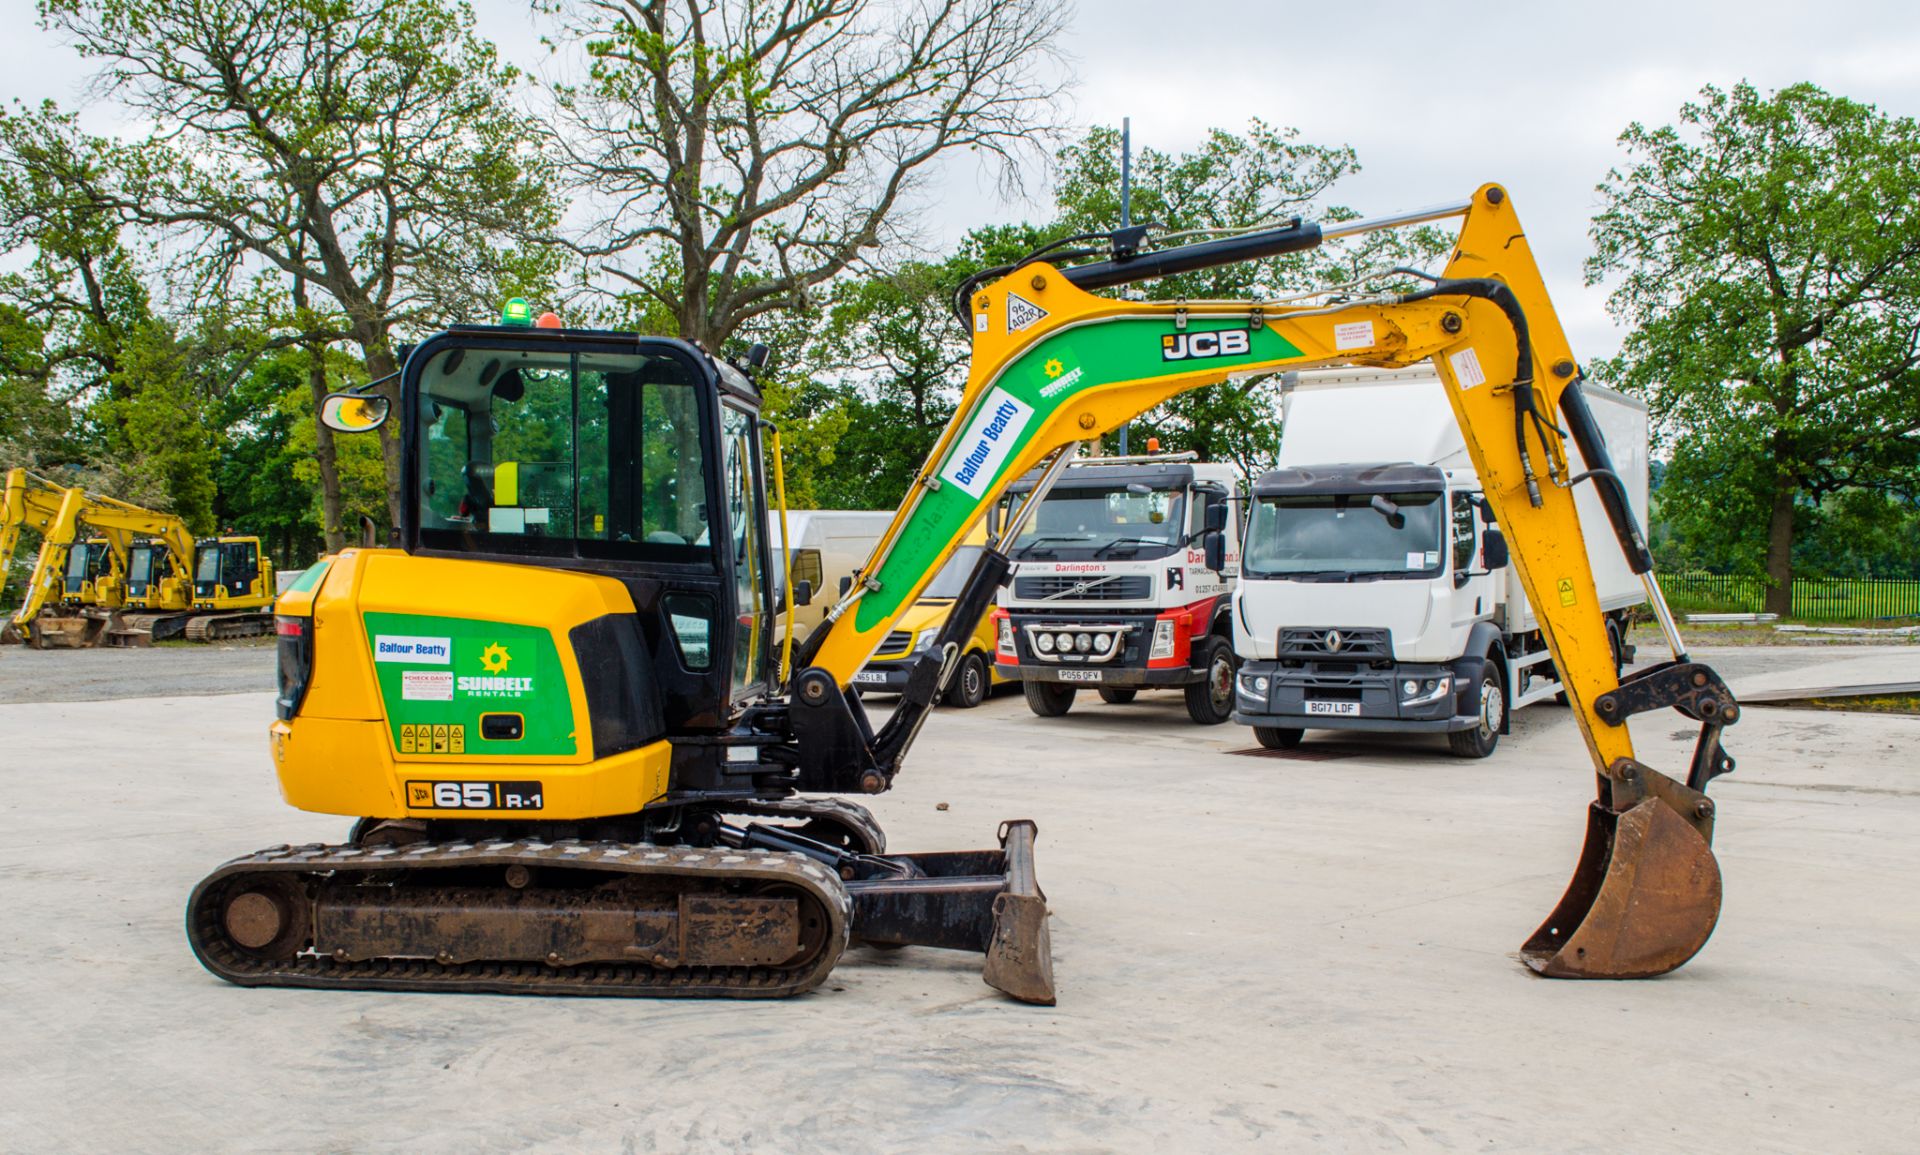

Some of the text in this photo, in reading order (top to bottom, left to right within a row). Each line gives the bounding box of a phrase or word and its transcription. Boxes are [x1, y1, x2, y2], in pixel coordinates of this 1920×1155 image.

[1011, 303, 1025, 315] 96
[1163, 329, 1249, 360] JCB
[954, 399, 1019, 486] Balfour Beatty
[1187, 550, 1239, 564] Daron's
[1055, 563, 1106, 573] Darlington's
[379, 642, 446, 657] Balfour Beatty
[457, 676, 533, 691] SUNBELT
[1311, 702, 1354, 713] BG17 LDF
[413, 782, 542, 808] JCB 65 R-1
